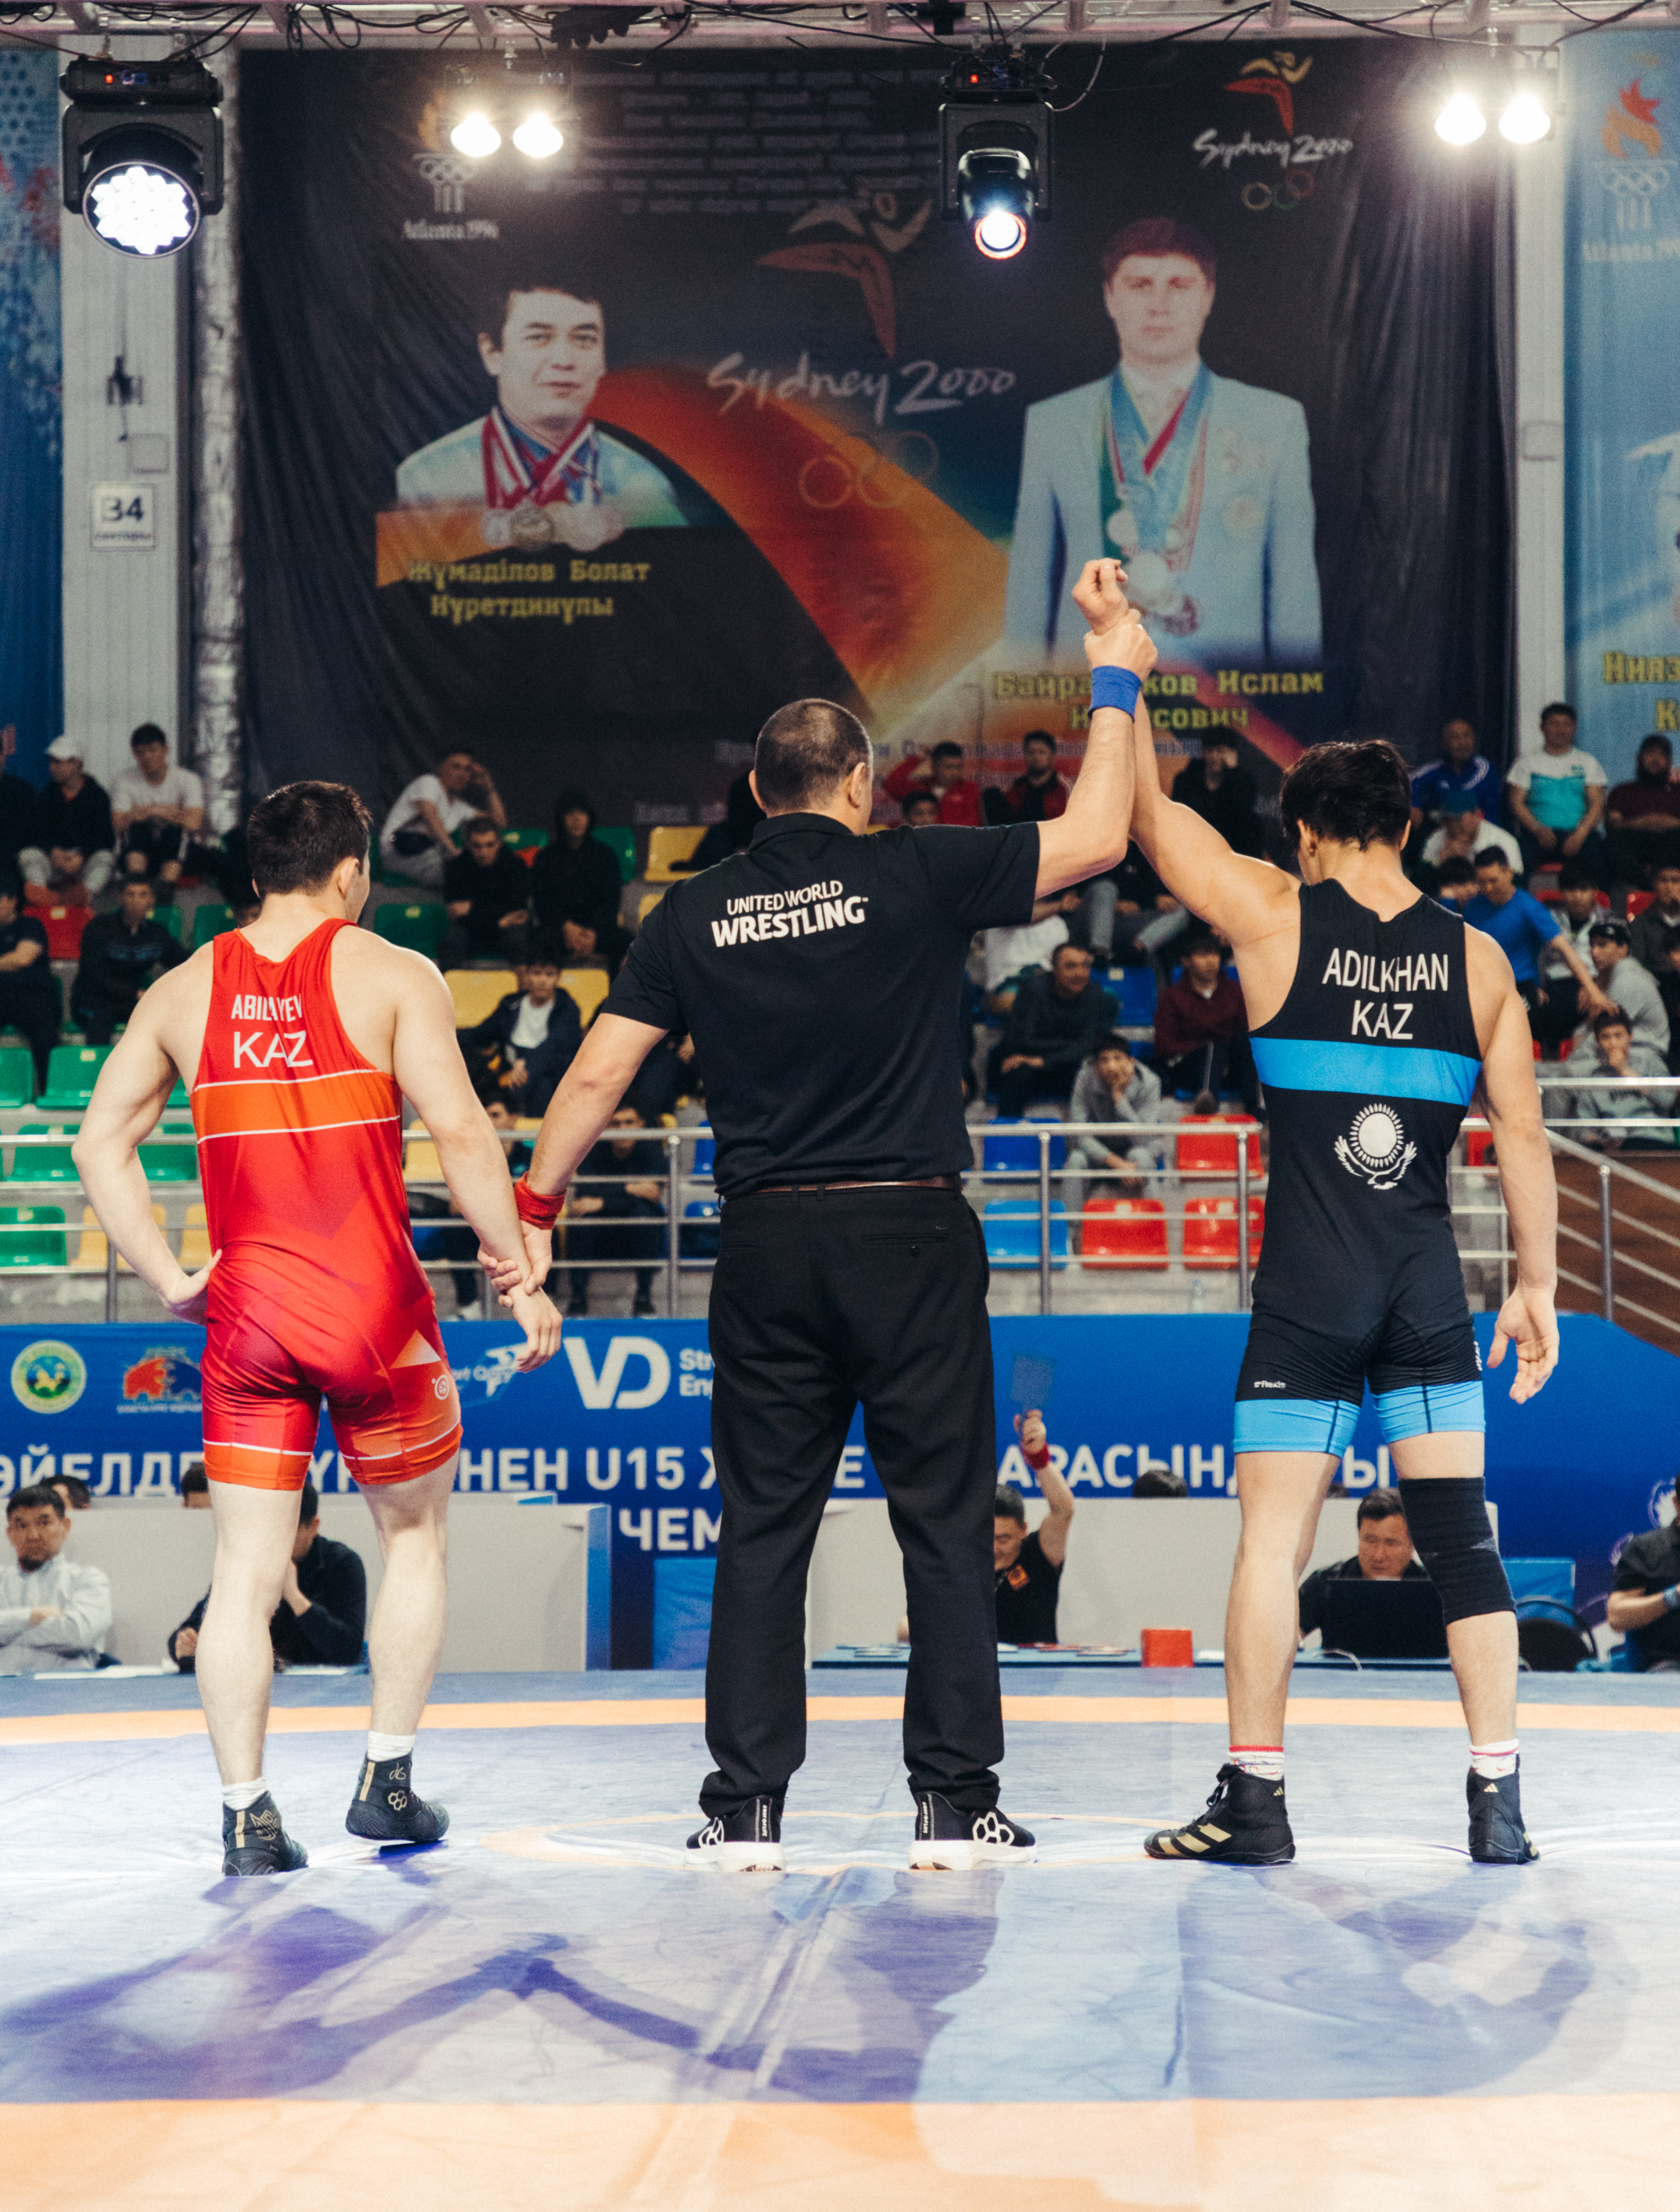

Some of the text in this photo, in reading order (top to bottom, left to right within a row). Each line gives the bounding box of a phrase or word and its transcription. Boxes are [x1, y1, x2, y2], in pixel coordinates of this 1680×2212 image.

[1193, 128, 1353, 169] Sydney 2000
[707, 350, 1016, 426] Sydney 2000
[100, 495, 144, 522] 34
[727, 880, 843, 915] UNITED WORLD
[711, 895, 865, 948] WRESTLING
[1322, 948, 1448, 993] ADILKHAN
[231, 994, 302, 1022] ABILAYEV
[1351, 999, 1413, 1040] KAZ
[234, 1030, 313, 1068] KAZ
[563, 1336, 671, 1410] VD
[586, 1446, 685, 1490] U15
